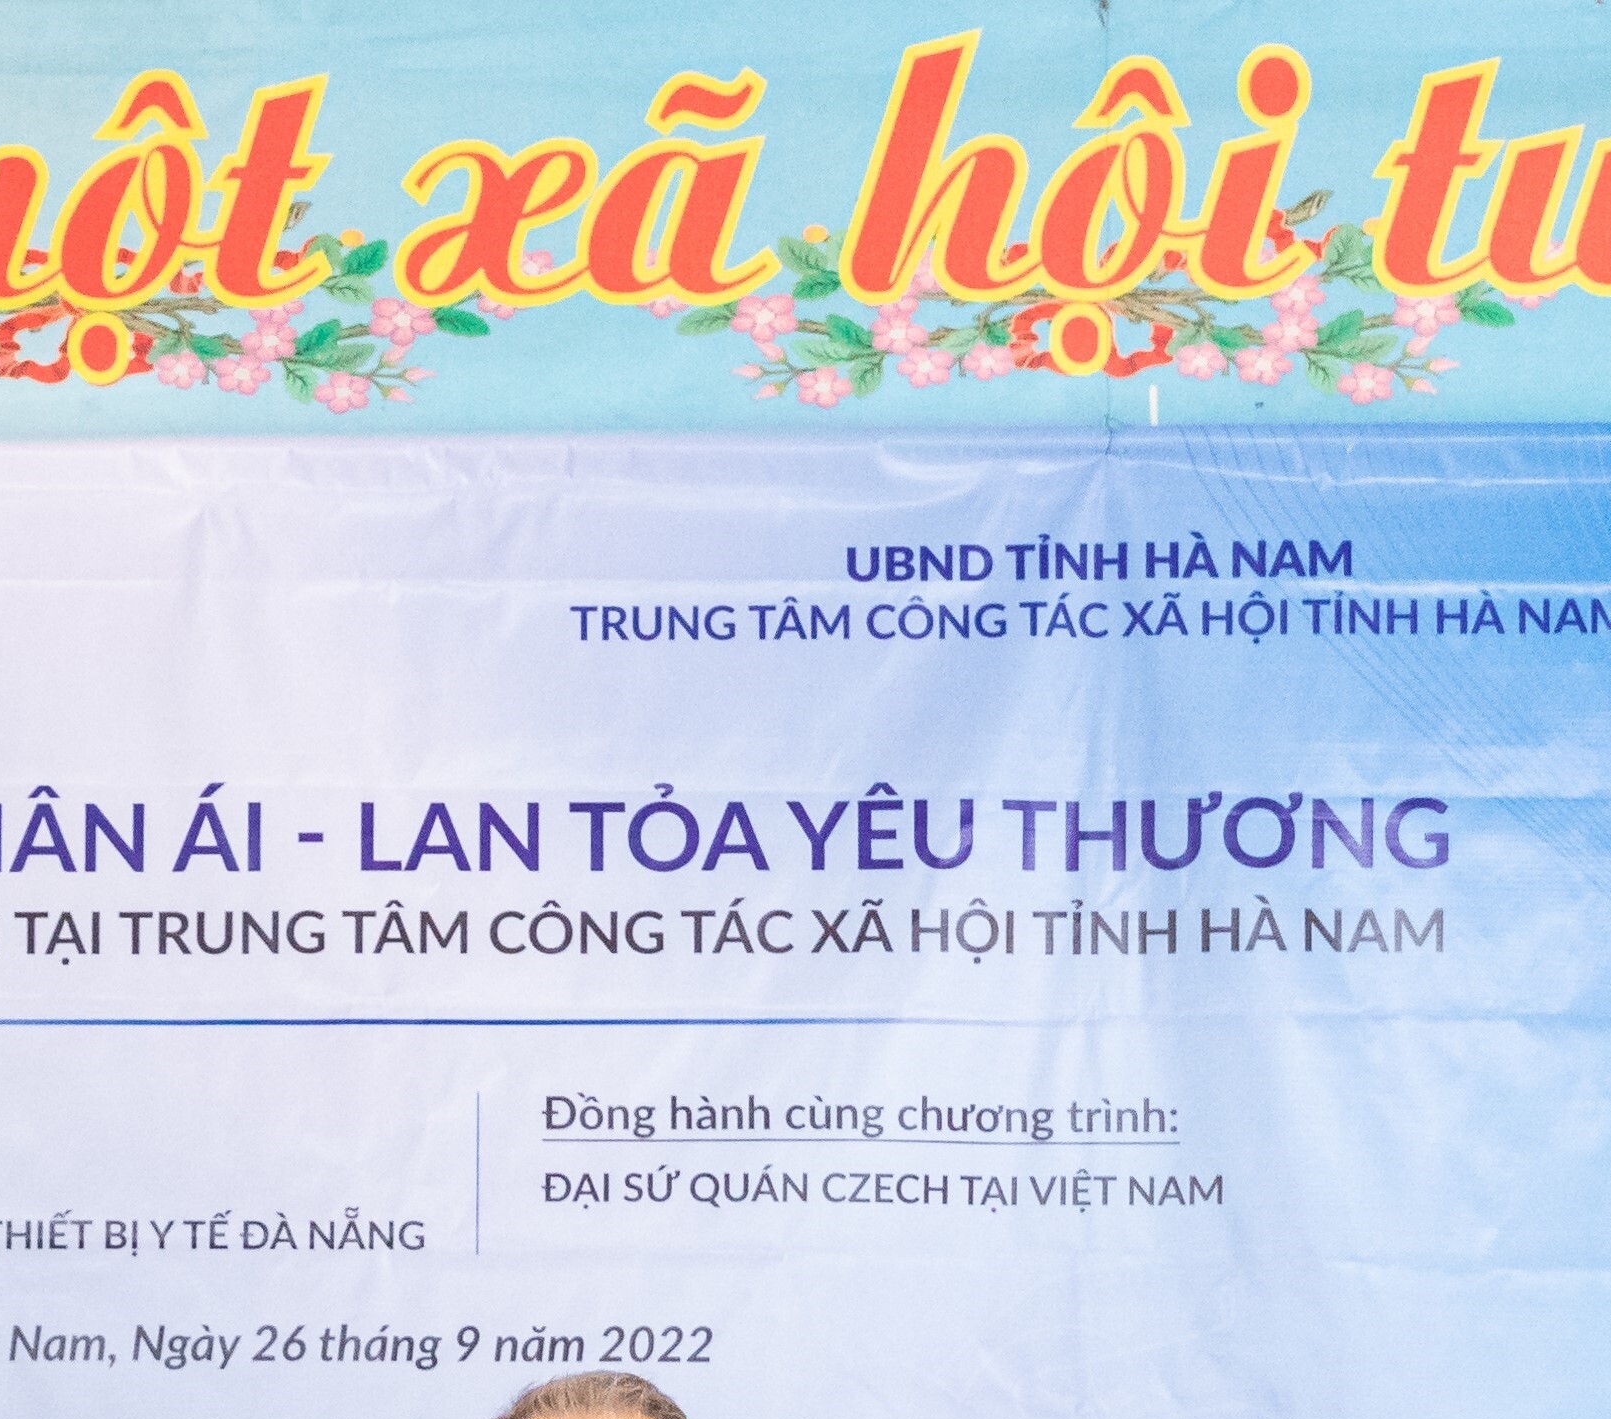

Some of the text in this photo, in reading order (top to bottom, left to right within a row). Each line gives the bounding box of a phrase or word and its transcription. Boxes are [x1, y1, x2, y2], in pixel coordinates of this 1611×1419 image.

[396, 66, 787, 308] xã
[837, 28, 1316, 376] hội
[845, 529, 1354, 583] UBND TỈNH HÀ NAM
[568, 604, 737, 643] TRUNG
[747, 595, 851, 641] TÂM
[865, 595, 1010, 643] CÔNG
[1017, 591, 1110, 640] TÁC
[1121, 591, 1190, 639] XÃ
[1201, 589, 1292, 646] HỘI
[1300, 590, 1422, 639] TỈNH
[1433, 589, 1506, 638] HÀ
[171, 781, 263, 874] ÁI
[297, 831, 325, 844] -
[359, 800, 541, 873] LAN
[567, 781, 771, 874] TỎA
[784, 780, 975, 872] YÊU
[1001, 793, 1452, 871] THƯƠNG
[13, 910, 102, 967] TẠI
[117, 909, 327, 956] TRUNG
[341, 898, 469, 956] TÂM
[488, 898, 665, 956] CÔNG
[679, 896, 795, 955] TÁC
[810, 897, 895, 955] XÃ
[910, 897, 1015, 965] HỘI
[1031, 900, 1179, 957] TỈNH
[1200, 893, 1288, 955] HÀ
[1303, 906, 1446, 954] NAM
[540, 1091, 1179, 1138] Đồng hành cùng chương trình:
[540, 1165, 1224, 1214] ĐẠI SỨ QUÁN CZECH TẠI VIỆT NAM
[103, 1219, 140, 1258] BỊ
[149, 1219, 176, 1251] Y
[181, 1208, 233, 1251] TẾ
[239, 1211, 299, 1252] ĐÀ
[308, 1208, 426, 1252] NẴNG
[8, 1324, 117, 1368] Nam,
[132, 1324, 242, 1371] Ngày
[251, 1324, 308, 1363] 26
[319, 1323, 443, 1372] tháng
[455, 1324, 481, 1363] 9
[494, 1326, 585, 1364] năm
[599, 1325, 715, 1364] 2022
